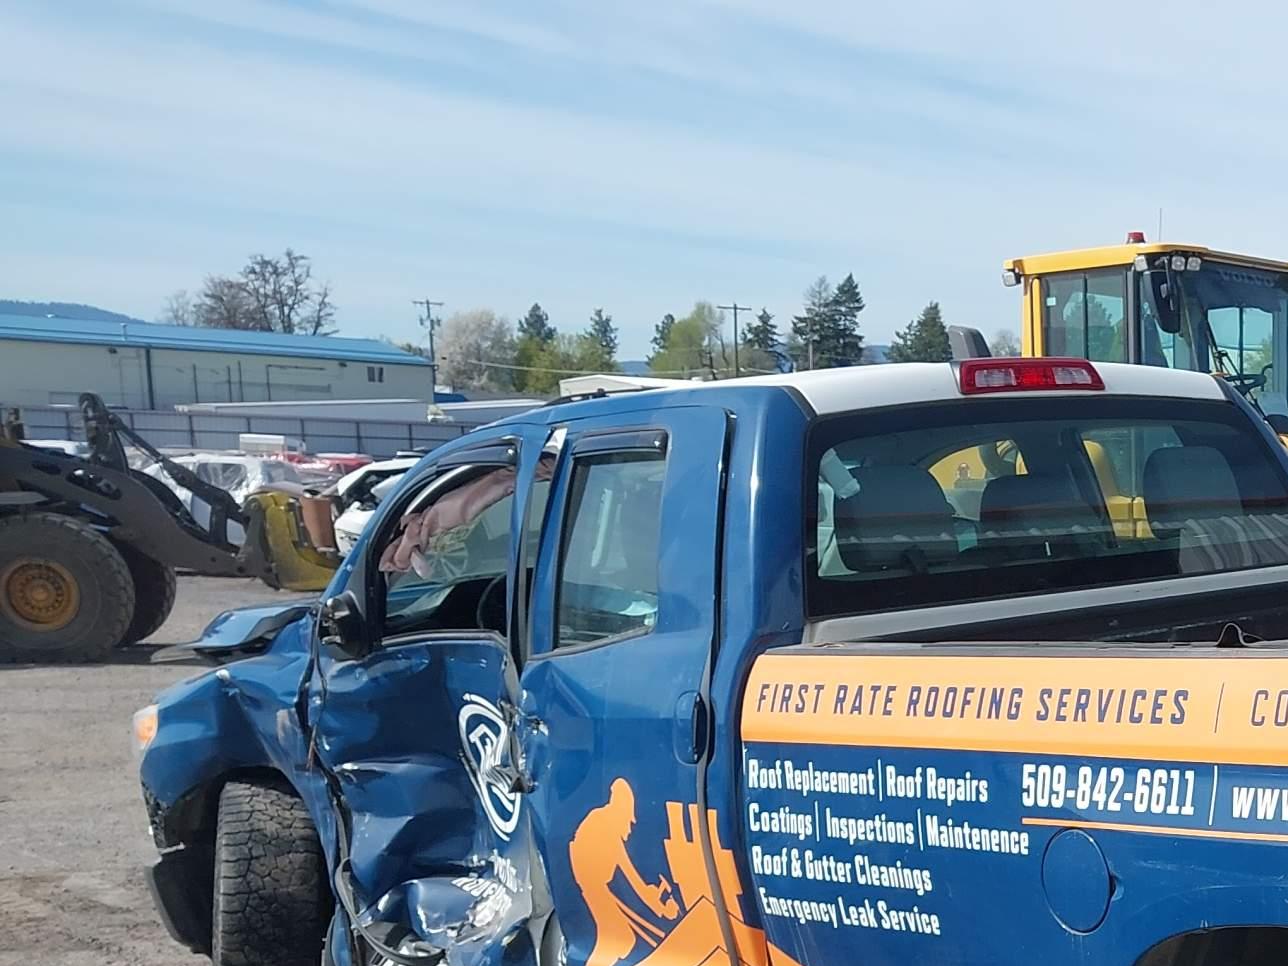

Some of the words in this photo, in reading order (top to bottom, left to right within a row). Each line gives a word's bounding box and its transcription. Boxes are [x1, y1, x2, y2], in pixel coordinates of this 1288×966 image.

[757, 684, 824, 713] FIRST
[834, 685, 896, 715] RATE
[906, 686, 1023, 720] ROOFING
[1037, 689, 1188, 724] SERVICES
[749, 759, 782, 788] Roof
[784, 761, 875, 796] Replacement
[886, 766, 922, 798] Roof
[927, 768, 987, 806] Repairs
[1022, 764, 1195, 816] 509-842-6611
[749, 803, 812, 840] Coatings
[826, 808, 914, 845] Inspections
[926, 816, 1029, 855] Maintenence
[752, 846, 787, 875] Roof
[791, 849, 802, 877] &
[805, 850, 851, 883] Gutter
[855, 855, 932, 895] Cleanings
[759, 887, 837, 928] Emergency
[838, 897, 878, 927] Leak
[877, 901, 940, 935] Service
